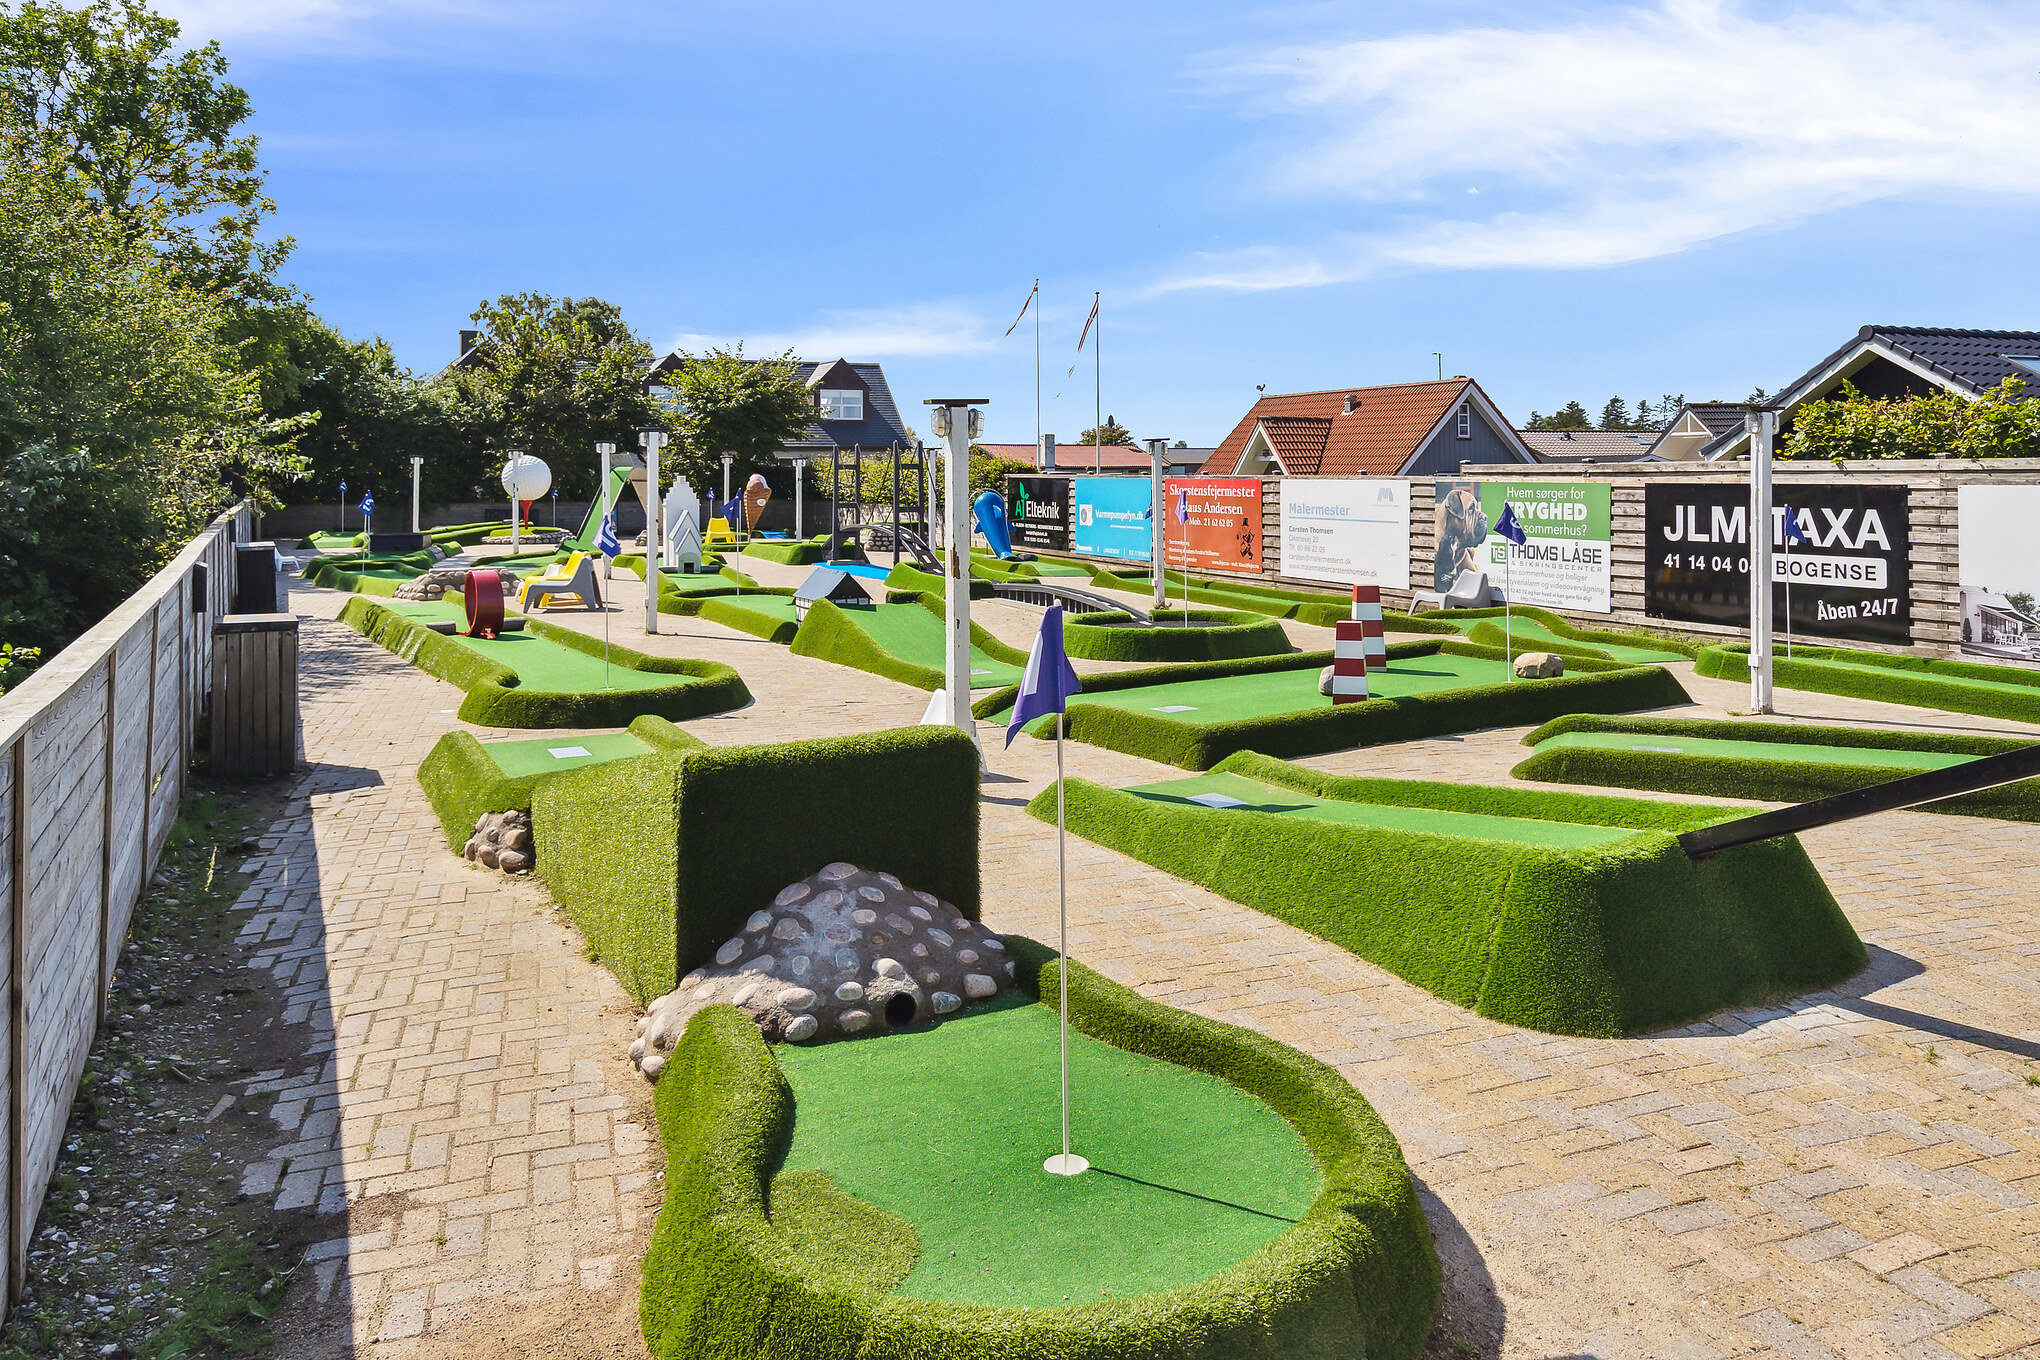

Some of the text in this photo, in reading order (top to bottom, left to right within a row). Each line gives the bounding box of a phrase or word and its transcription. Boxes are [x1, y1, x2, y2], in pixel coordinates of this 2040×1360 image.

[1506, 486, 1586, 502] Hvem sørger for
[1026, 500, 1060, 519] Elteknik
[1185, 501, 1244, 515] laus Andersen
[1289, 503, 1351, 516] Malermester
[1189, 517, 1233, 528] Mob. 21 62 62 05
[1523, 523, 1588, 536] sommerhus?
[1771, 507, 1892, 551] TAXA
[1288, 525, 1334, 535] Carsten Thomsen
[1311, 545, 1318, 553] 22
[1509, 543, 1558, 561] THOMS
[1562, 541, 1602, 564] LÅSE
[1519, 561, 1603, 573] SIKRINGSCENTER
[1663, 553, 1752, 573] 41 14 04 0
[1518, 569, 1556, 579] sommerhuse
[1556, 573, 1564, 581] og
[1565, 573, 1588, 583] boliger
[1776, 560, 1877, 581] BOGENSE
[1541, 582, 1549, 590] og
[1817, 598, 1899, 621] Åben 24/7
